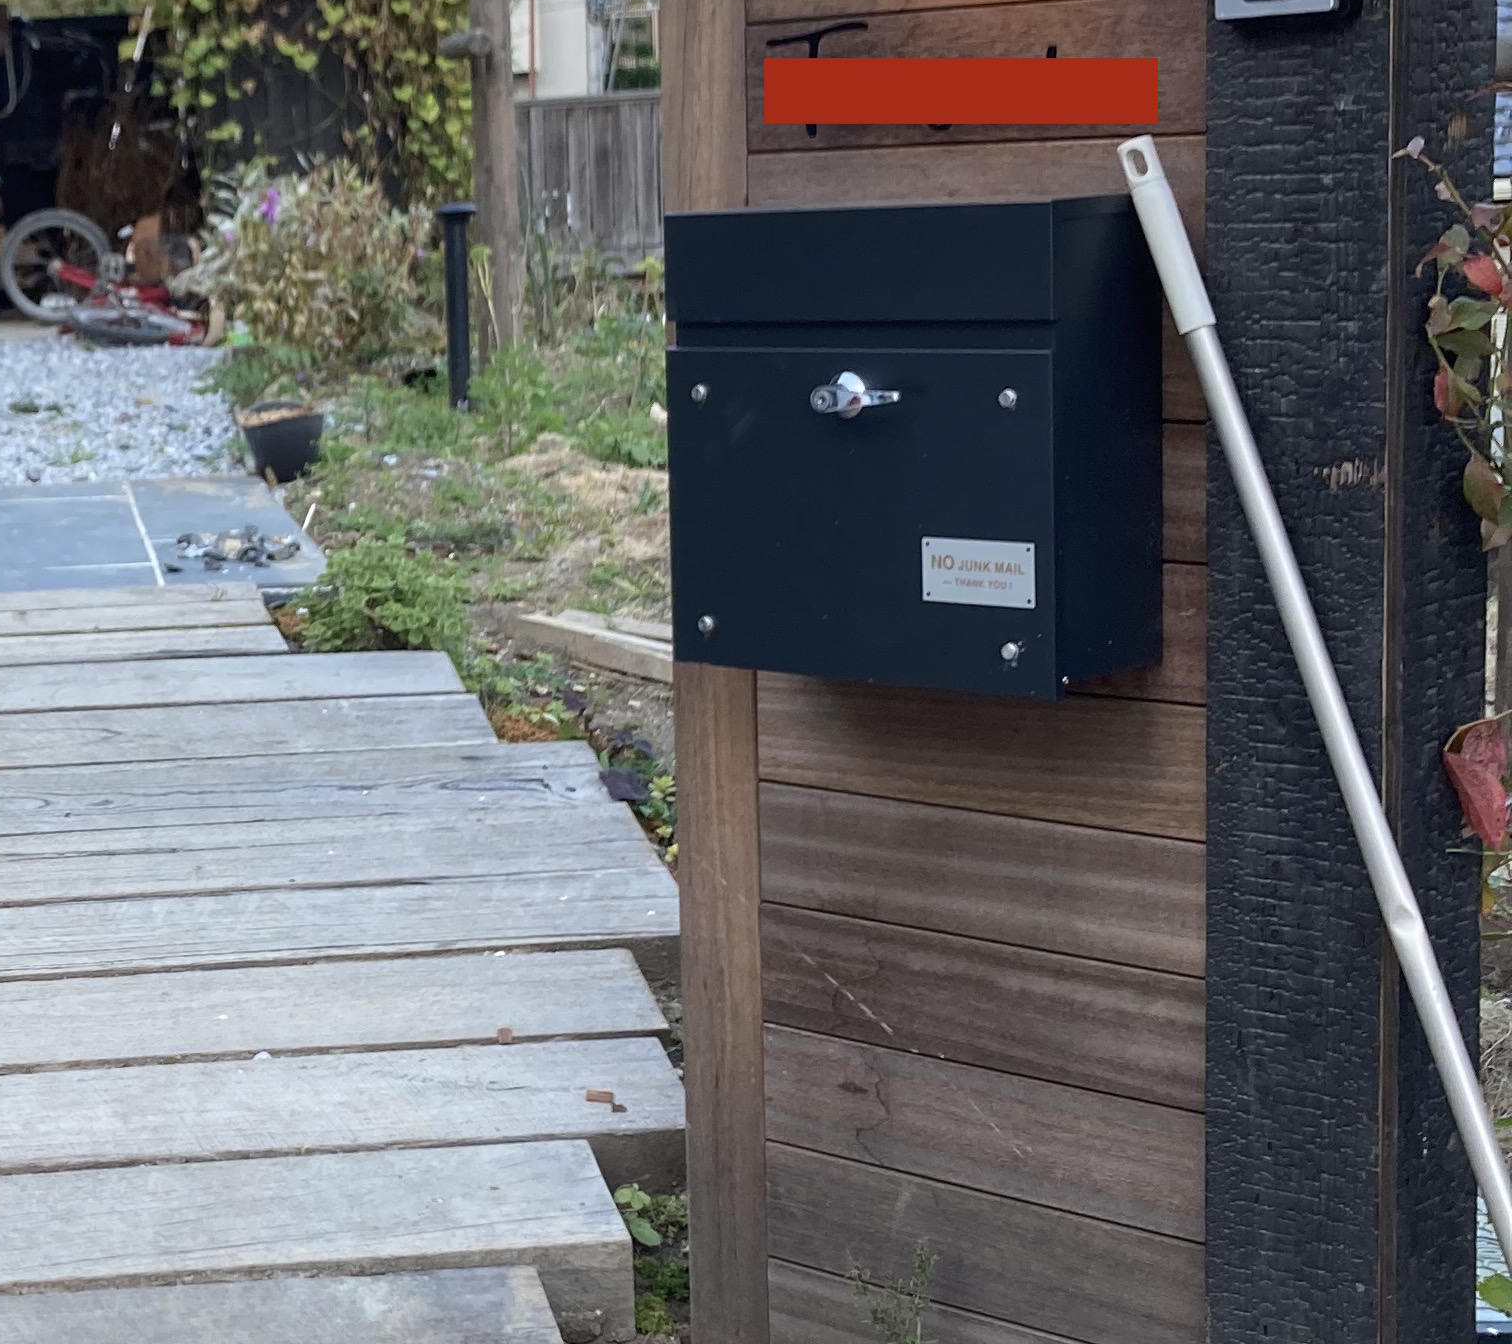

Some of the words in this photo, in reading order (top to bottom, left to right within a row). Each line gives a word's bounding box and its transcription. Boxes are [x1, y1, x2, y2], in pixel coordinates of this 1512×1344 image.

[931, 554, 955, 570] NO
[957, 560, 991, 572] JUNK
[994, 561, 1025, 576] MAIL
